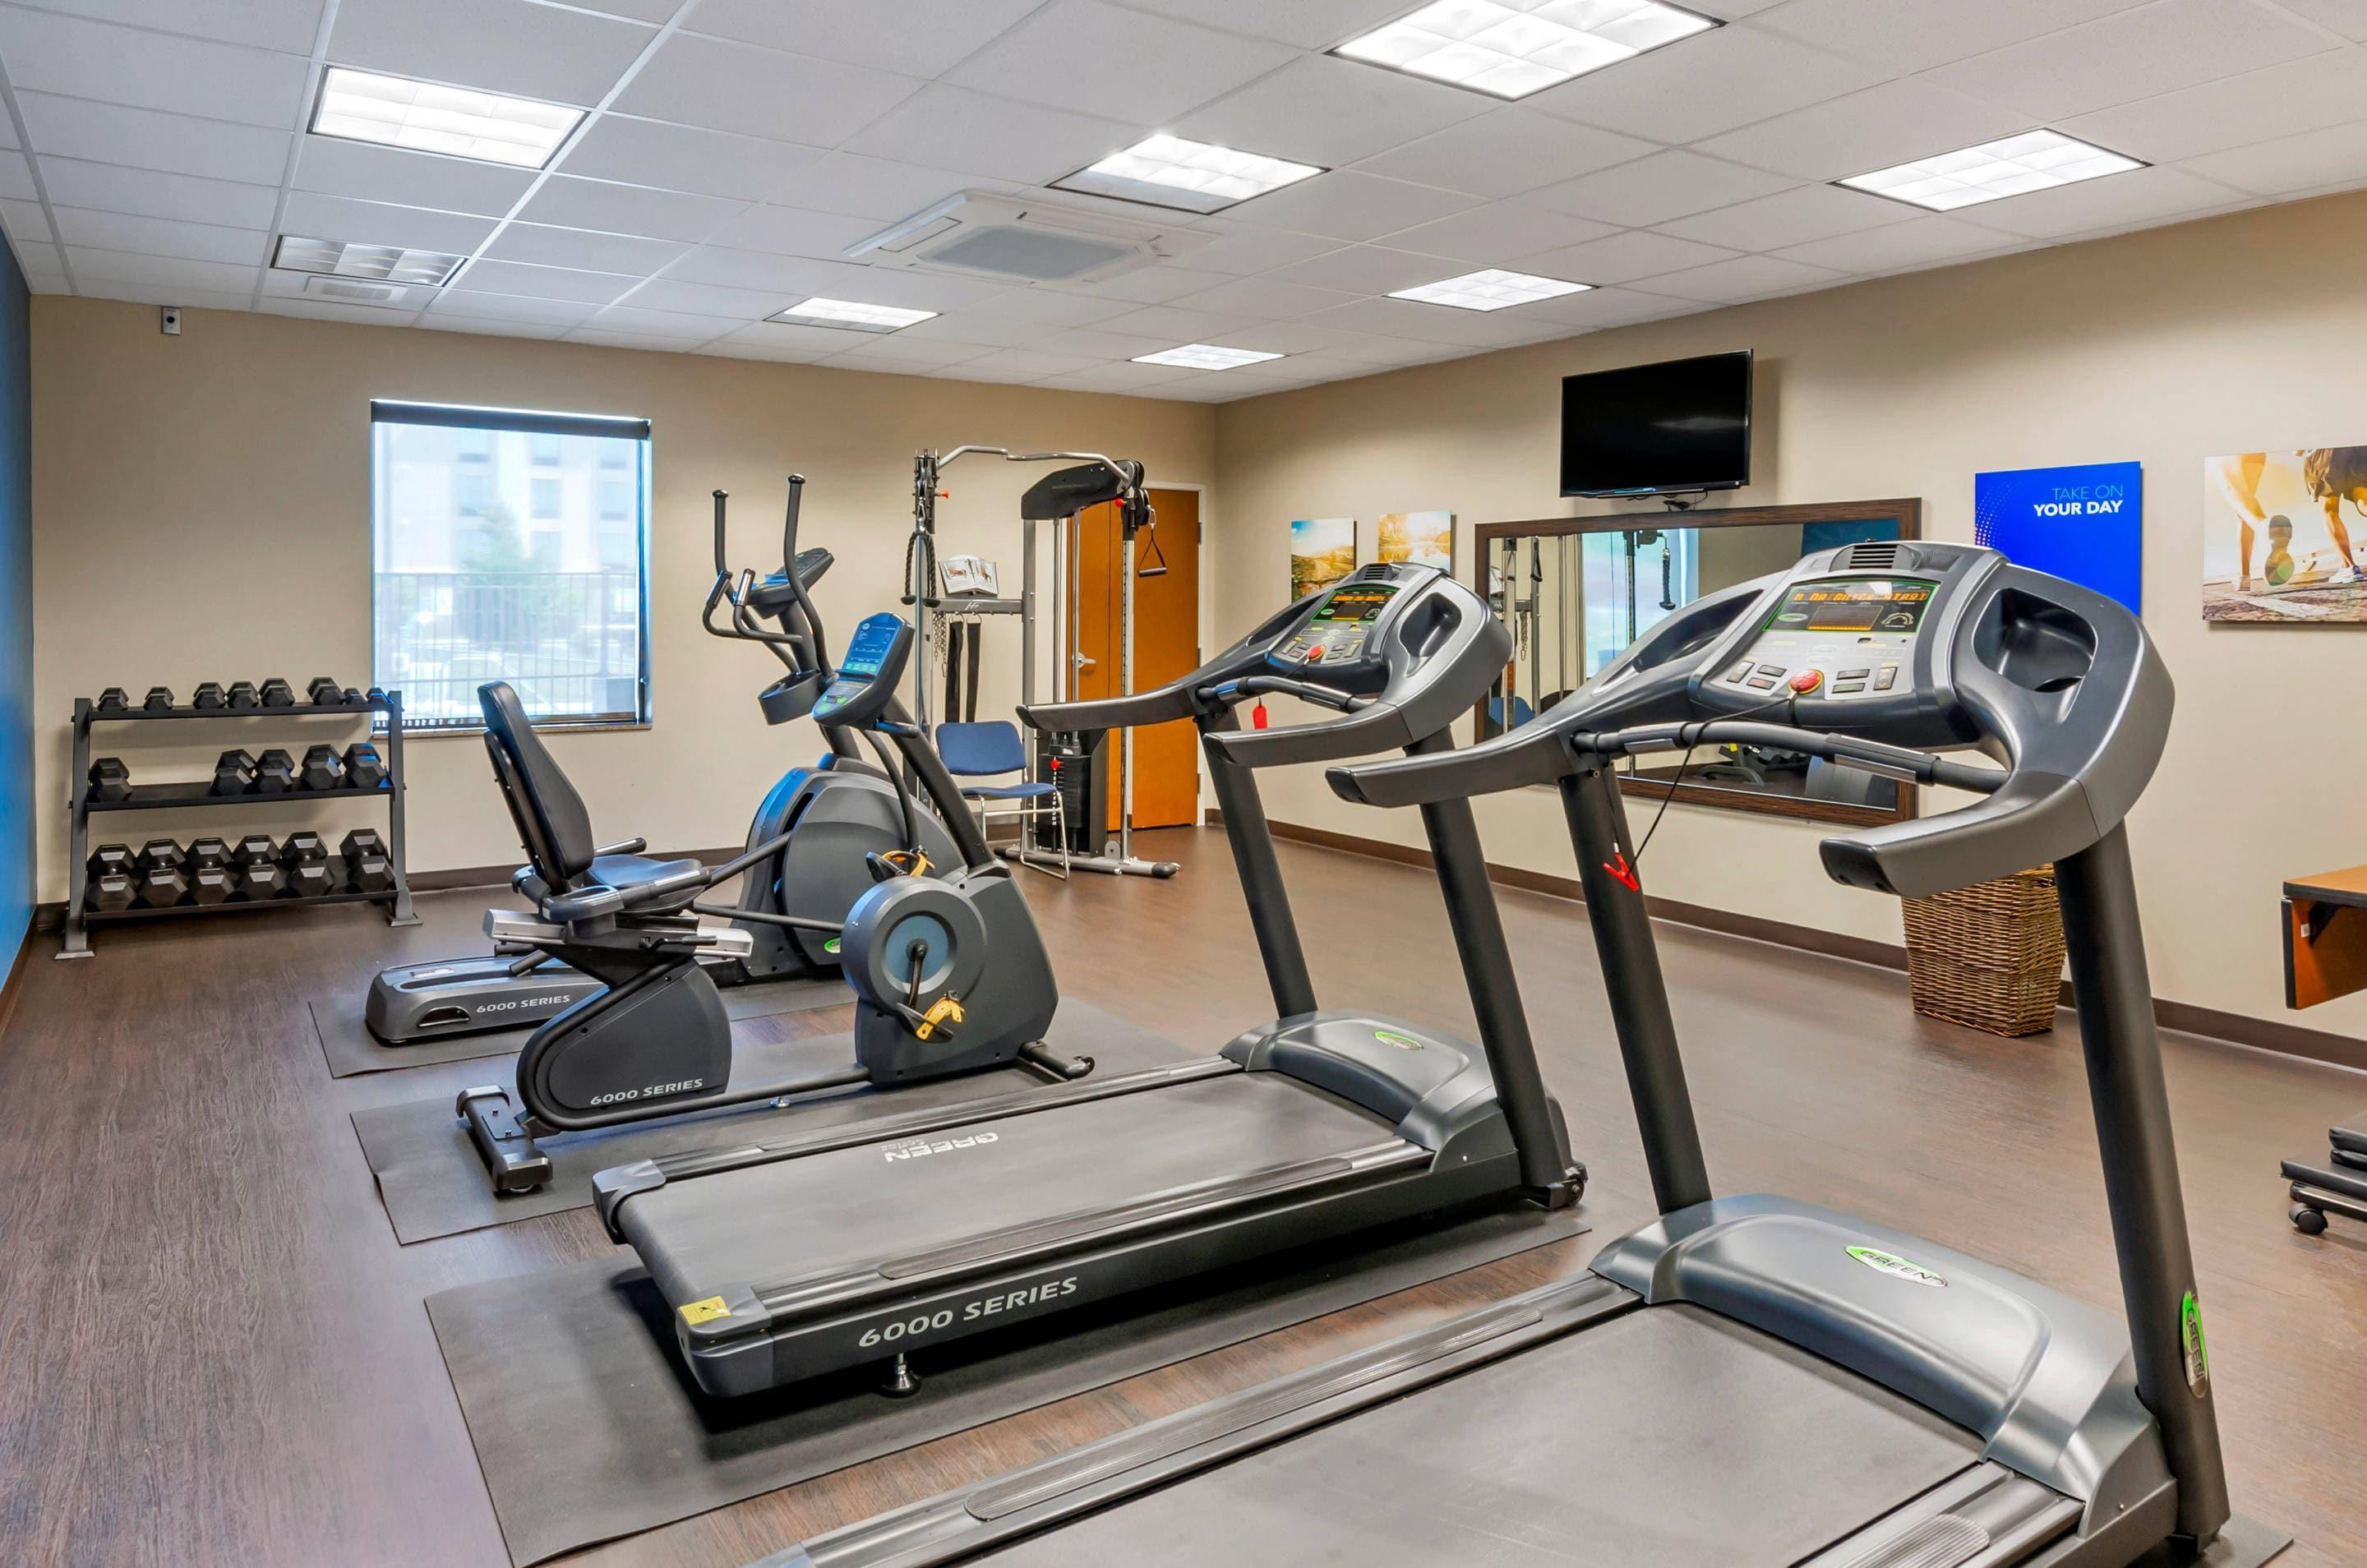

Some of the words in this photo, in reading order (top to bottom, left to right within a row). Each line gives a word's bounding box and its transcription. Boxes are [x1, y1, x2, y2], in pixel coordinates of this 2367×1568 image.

[2051, 486, 2091, 501] TAKE
[2095, 484, 2124, 499] ON
[2033, 501, 2082, 517] YOUR
[2087, 500, 2124, 514] DAY
[476, 1002, 516, 1013] 6000
[520, 994, 570, 1008] SERIES
[590, 1090, 639, 1105] 6000
[642, 1078, 704, 1097] SERIES
[884, 1132, 999, 1163] GREEN
[1861, 1251, 1933, 1280] GREEN
[858, 1310, 953, 1347] 6000
[963, 1276, 1077, 1321] SERIES
